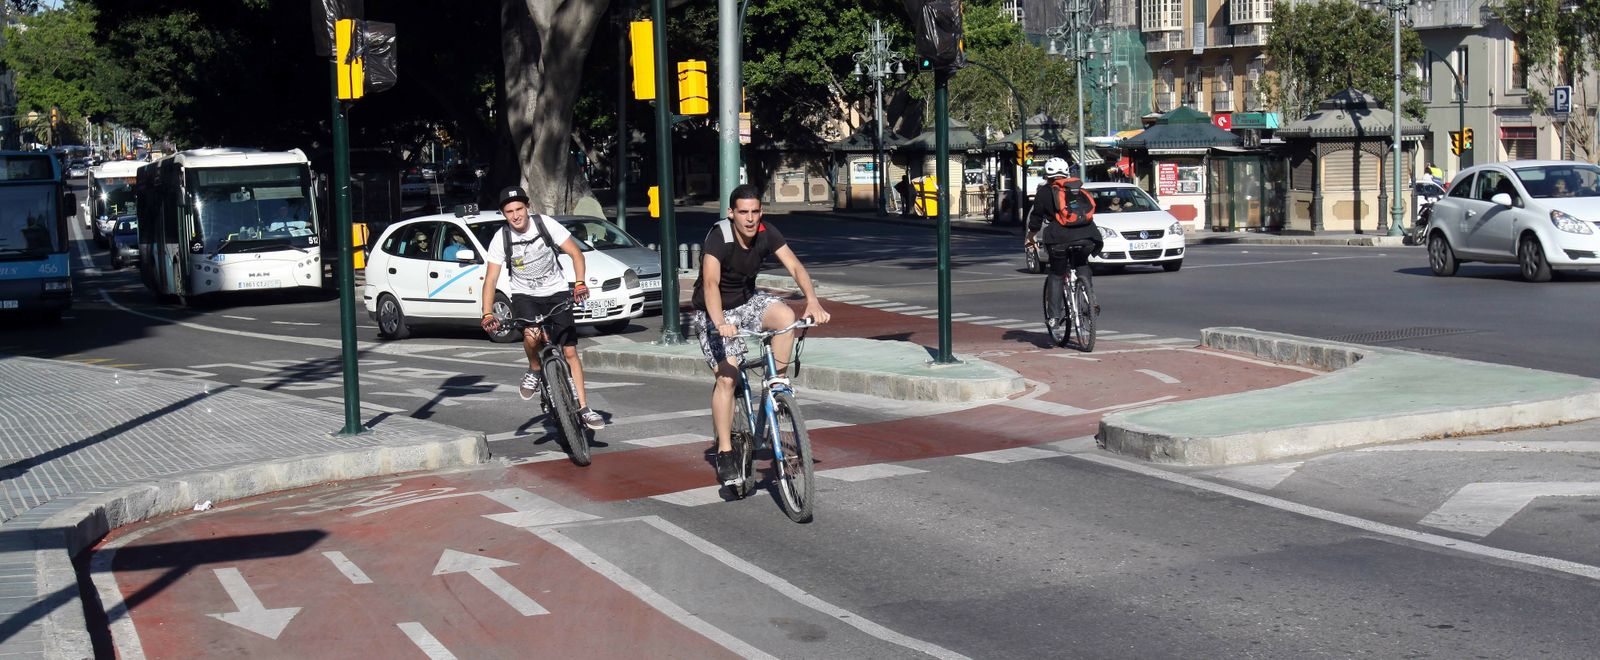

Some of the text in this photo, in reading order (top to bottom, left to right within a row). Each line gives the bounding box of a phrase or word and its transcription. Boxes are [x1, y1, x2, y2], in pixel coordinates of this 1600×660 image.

[1556, 89, 1567, 111] P
[463, 203, 480, 213] 123
[308, 236, 319, 245] 512
[38, 263, 58, 274] 456
[603, 299, 616, 308] CNS
[593, 308, 606, 317] SP
